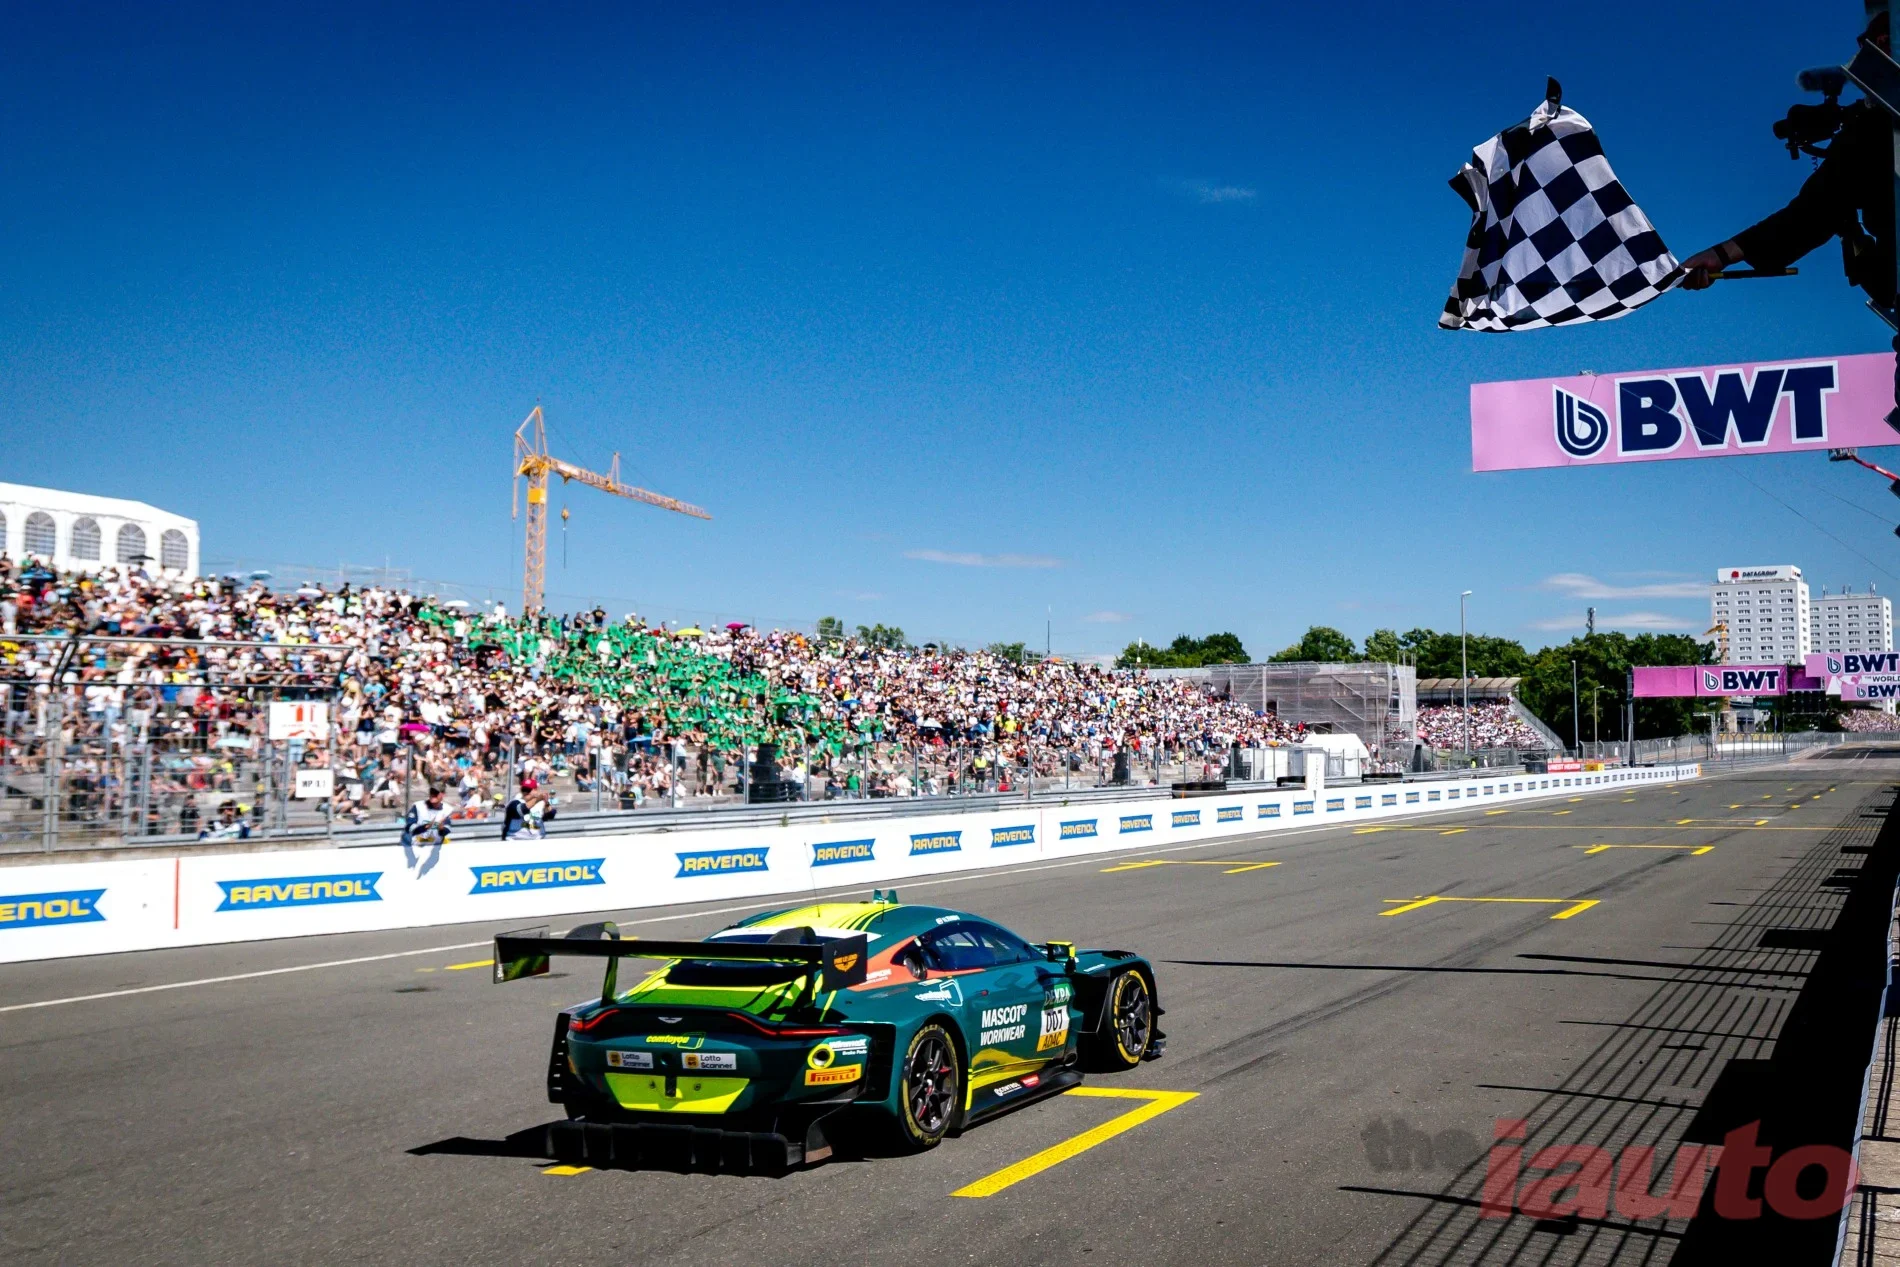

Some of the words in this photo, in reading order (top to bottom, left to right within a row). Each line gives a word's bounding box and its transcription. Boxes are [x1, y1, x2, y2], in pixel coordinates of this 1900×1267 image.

[1616, 362, 1838, 456] BWT
[1742, 570, 1778, 578] DATAGROUP
[1843, 653, 1899, 674] BWT
[1723, 671, 1779, 690] BWT
[1121, 819, 1151, 832] RAVENOL
[1173, 814, 1199, 825] RAVENOL
[993, 829, 1032, 844] RAVENOL
[1062, 823, 1096, 836] RAVENOL
[913, 836, 958, 851] RAVENOL
[816, 845, 871, 862] RAVENOL
[683, 853, 764, 872] RAVENOL
[480, 867, 597, 888] RAVENOL
[230, 880, 372, 904] RAVENOL
[1045, 986, 1071, 1005] DEKRA
[1046, 1009, 1063, 1033] 007
[645, 1034, 690, 1045] comtoyou
[980, 1024, 1026, 1046] WORKWEAR
[1043, 1031, 1062, 1050] ADAC
[621, 1052, 640, 1060] Lotto
[700, 1054, 721, 1062] Lotto
[622, 1060, 650, 1069] Scanner
[700, 1061, 733, 1069] Scanner
[810, 1068, 857, 1082] PIRELLI
